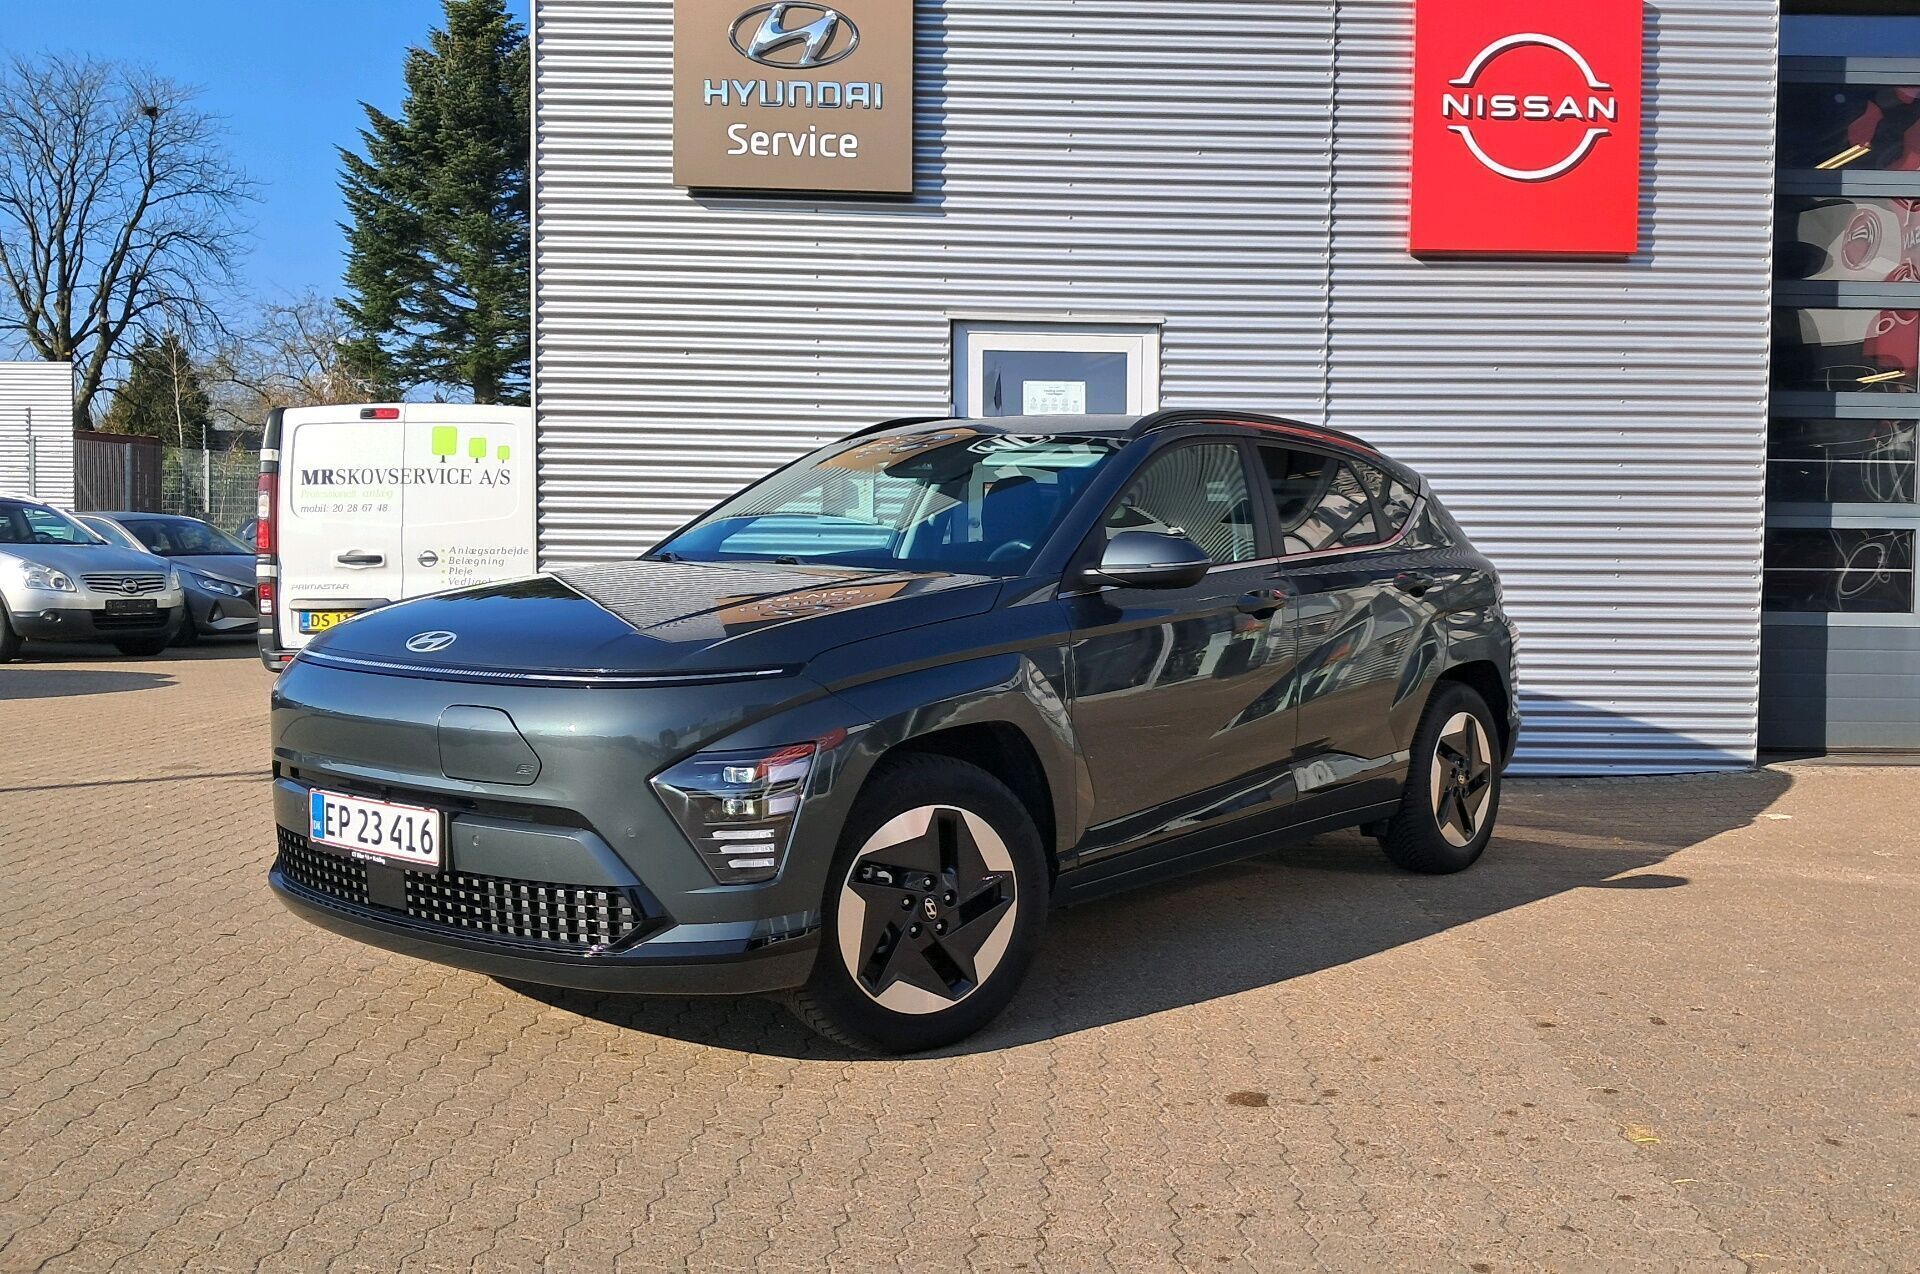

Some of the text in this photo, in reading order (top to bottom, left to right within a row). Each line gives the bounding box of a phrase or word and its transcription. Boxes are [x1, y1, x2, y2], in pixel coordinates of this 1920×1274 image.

[703, 78, 883, 109] HYUNDAI
[1442, 93, 1617, 122] NISSAN
[726, 123, 858, 158] Service
[478, 467, 511, 489] A/S
[300, 503, 329, 513] mobil:
[332, 503, 344, 513] 20
[347, 503, 358, 513] 28
[361, 503, 373, 512] 67
[448, 546, 529, 557] Anlægsarbejde
[448, 556, 505, 567] Belægning
[448, 567, 473, 577] Pleje
[311, 613, 330, 627] DS
[313, 819, 322, 831] DK
[325, 802, 434, 855] EP 23 416
